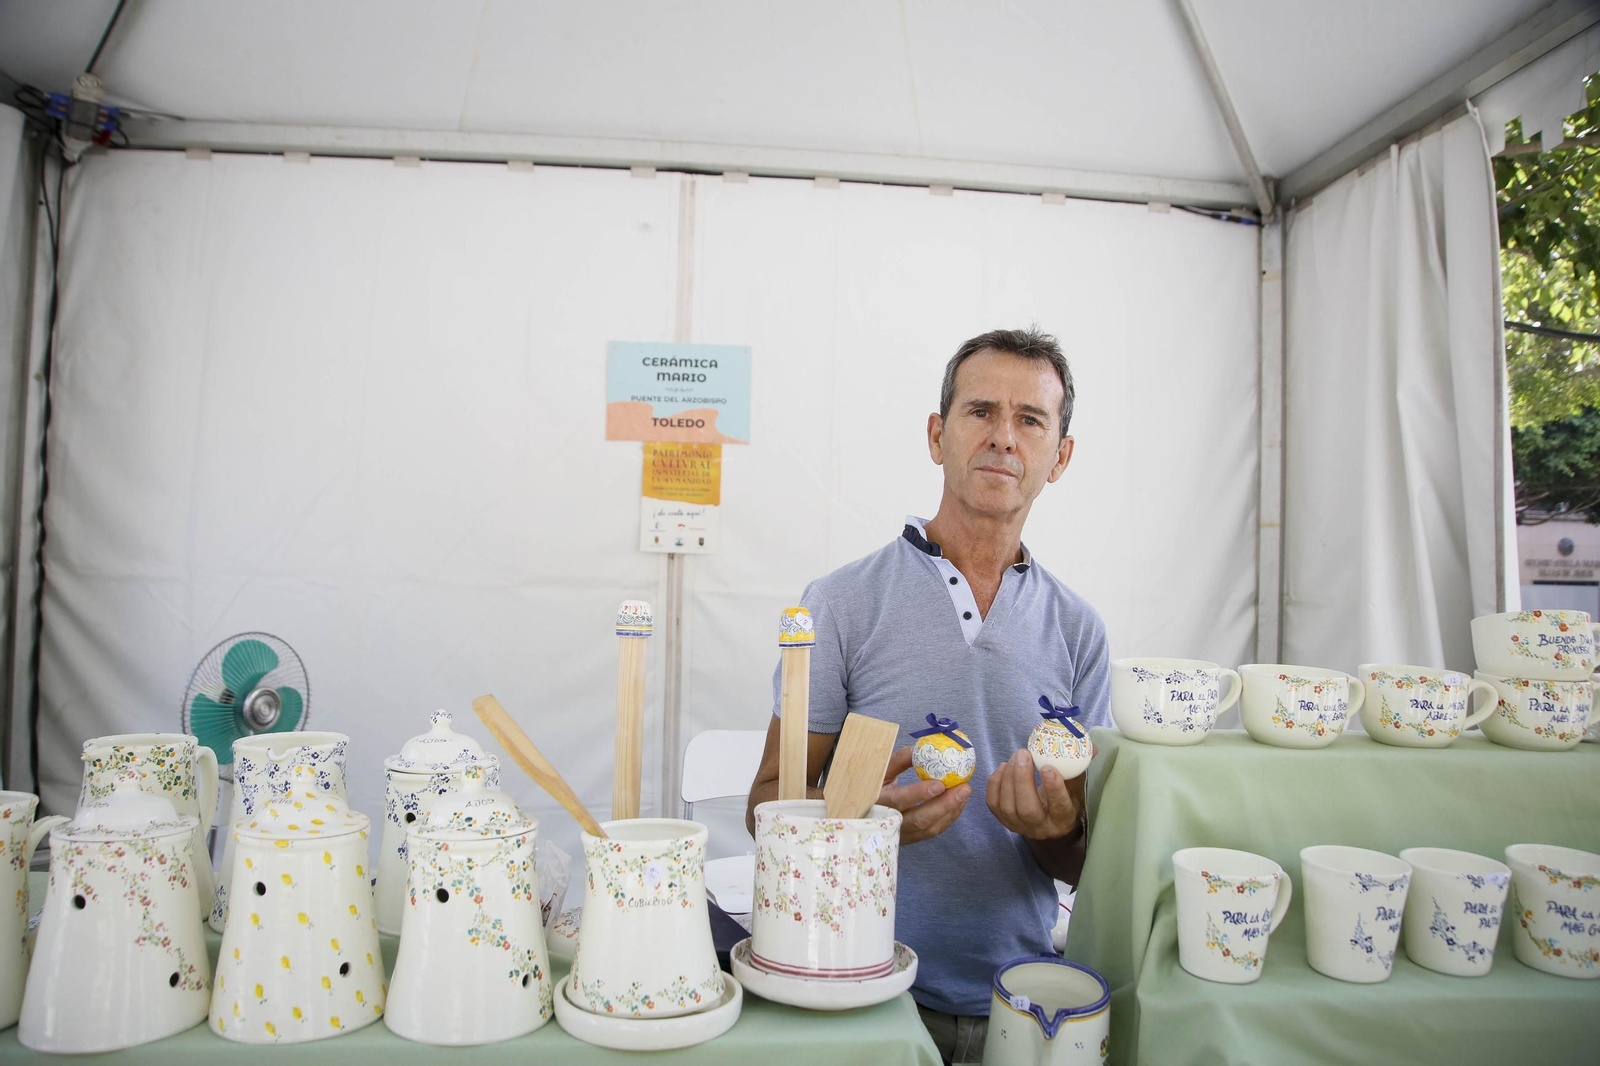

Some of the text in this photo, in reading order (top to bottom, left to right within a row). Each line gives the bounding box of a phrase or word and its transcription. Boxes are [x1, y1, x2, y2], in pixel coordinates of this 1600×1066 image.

[642, 355, 718, 369] CERÁMICA
[656, 371, 707, 383] MARIO
[631, 395, 727, 404] PUENTE DEL ARZOBISPO
[651, 417, 705, 428] TOLEDO
[652, 449, 713, 459] PATRIMONIO
[1537, 633, 1577, 647] BUENOS
[1170, 689, 1195, 702] PARA
[1198, 693, 1206, 701] EL
[1298, 700, 1320, 712] PARA
[1410, 699, 1435, 711] PARA
[1528, 697, 1556, 712] PARA
[1559, 706, 1570, 714] LA
[1463, 901, 1489, 915] PARA
[1546, 899, 1580, 922] PARA
[1580, 910, 1595, 920] LA
[1222, 910, 1249, 926] PARA
